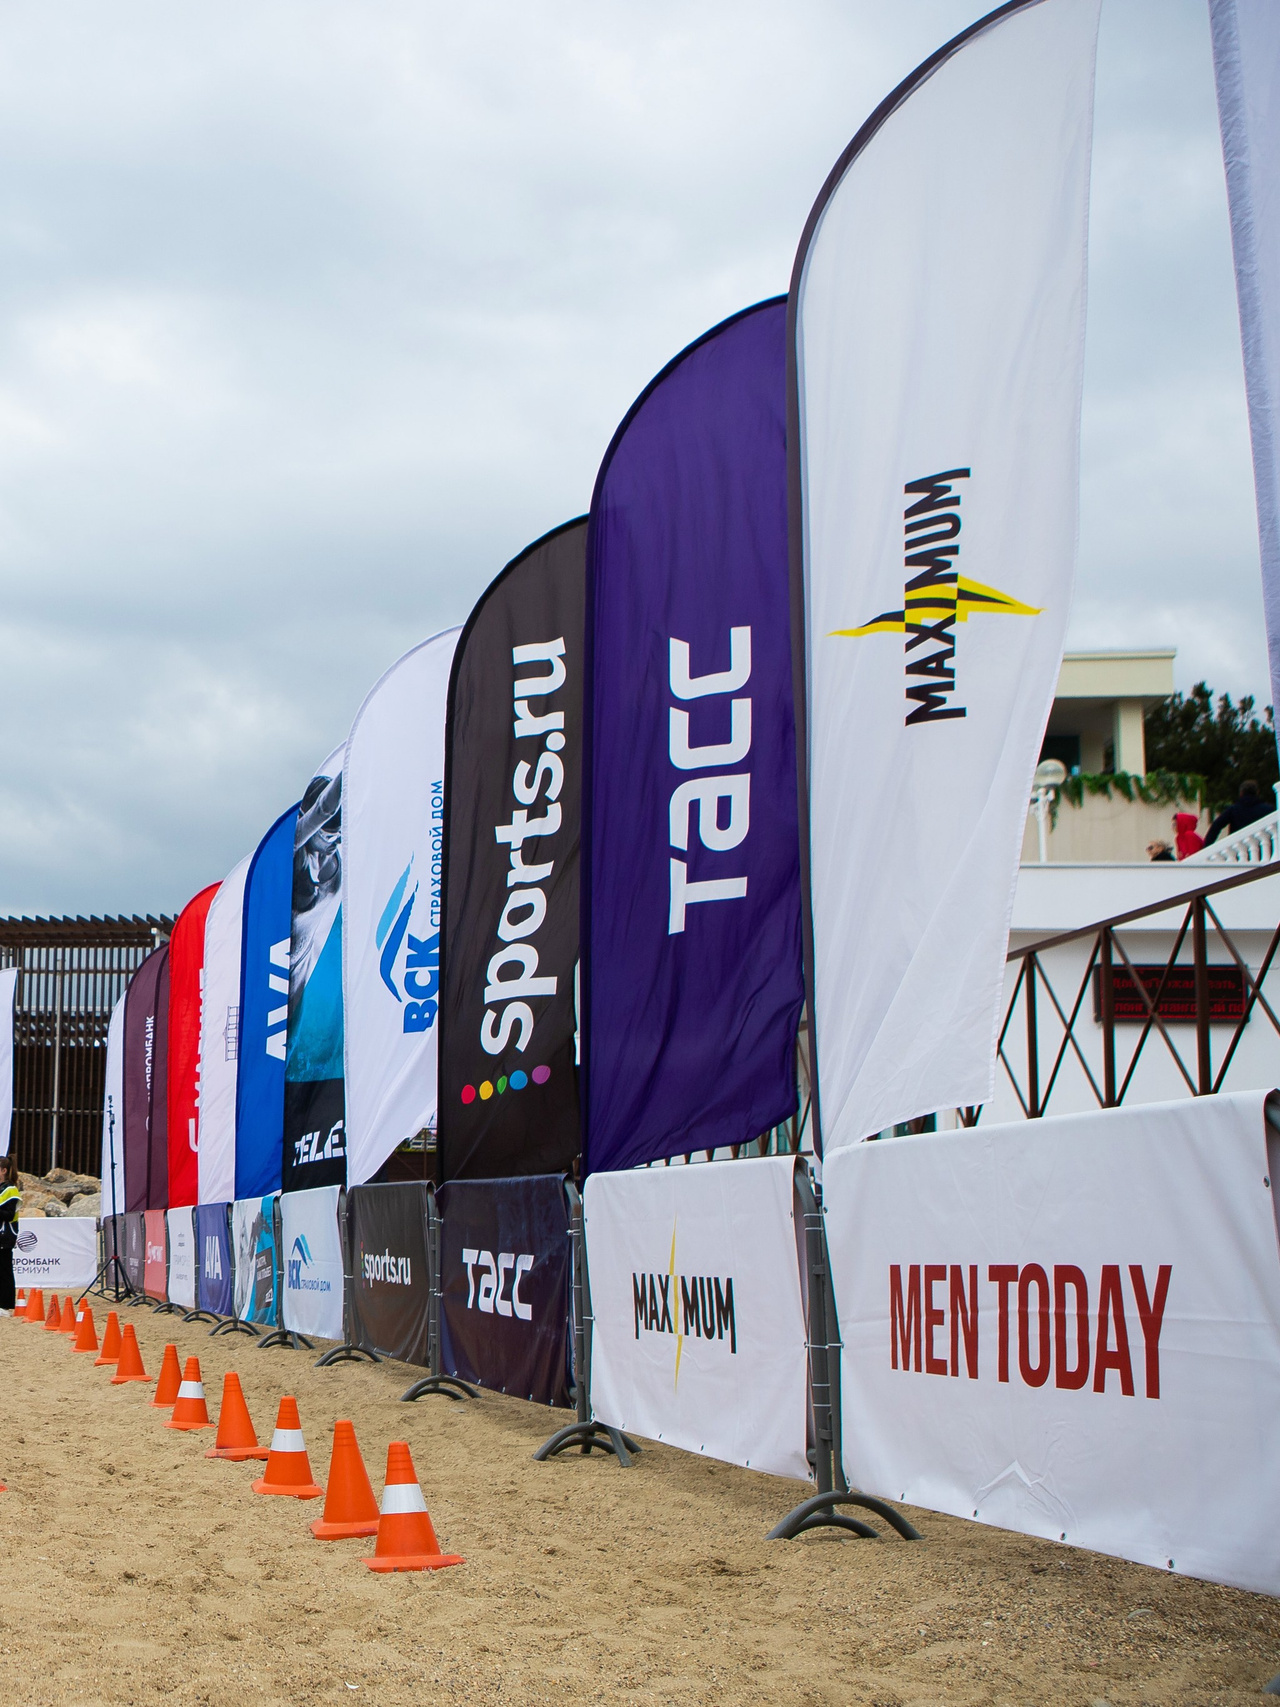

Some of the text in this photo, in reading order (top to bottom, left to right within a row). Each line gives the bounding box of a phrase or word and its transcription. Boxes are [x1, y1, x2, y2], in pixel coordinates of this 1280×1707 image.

[429, 780, 444, 928] СТРАХОВОЙ ДОМ
[480, 636, 567, 1054] sports.ru
[403, 931, 441, 1034] ВСК
[205, 1235, 223, 1280] AVA
[364, 1243, 413, 1288] sports.ru
[889, 1262, 1173, 1400] MEN TODAY
